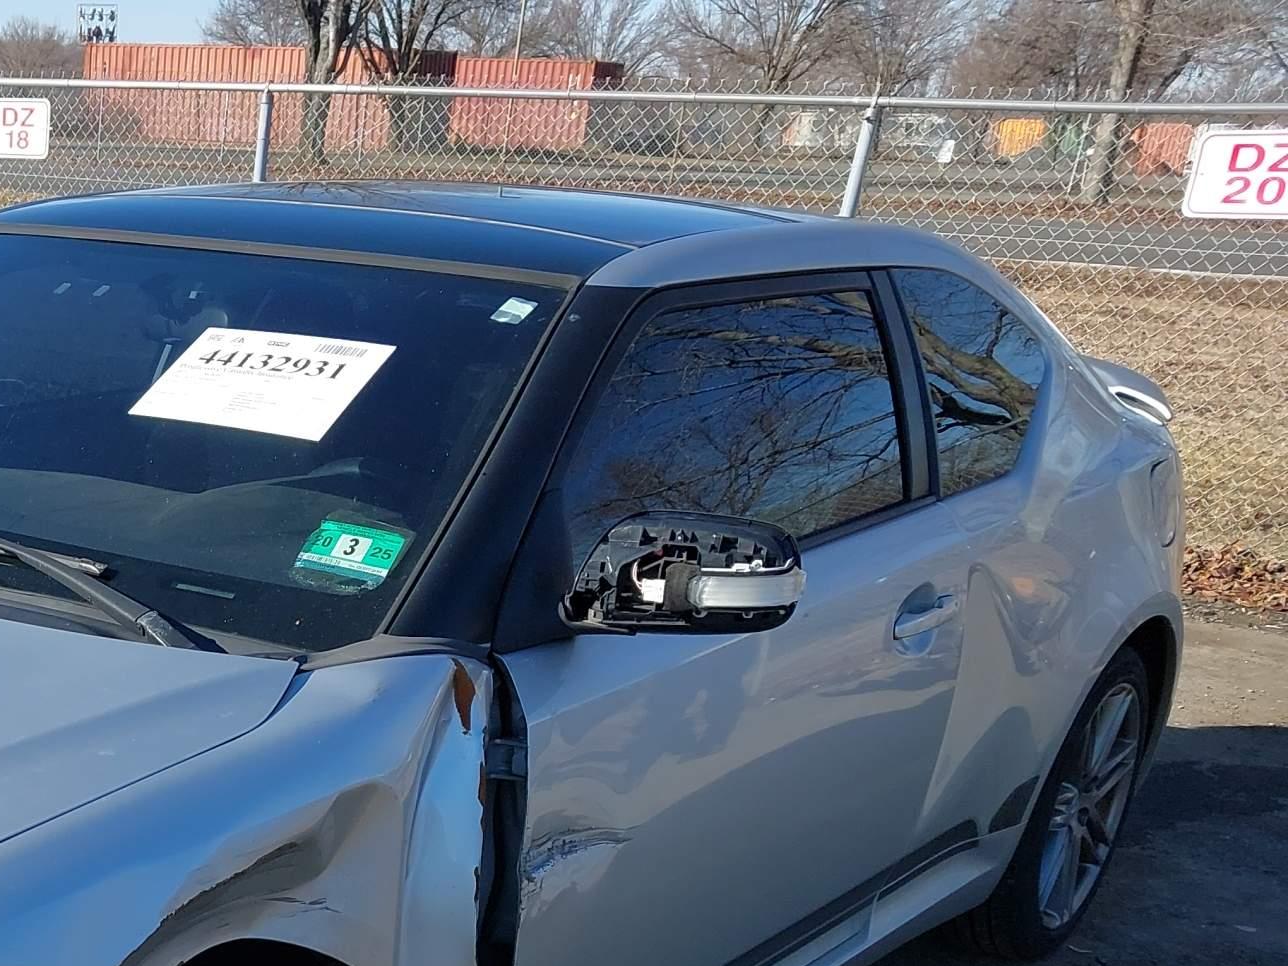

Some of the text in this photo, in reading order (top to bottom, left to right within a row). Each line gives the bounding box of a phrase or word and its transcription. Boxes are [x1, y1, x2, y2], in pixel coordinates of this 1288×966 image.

[2, 107, 35, 127] DZ
[5, 130, 29, 149] 18
[1221, 176, 1286, 205] 20
[198, 349, 347, 380] 44132931
[312, 534, 394, 561] 20 3 25
